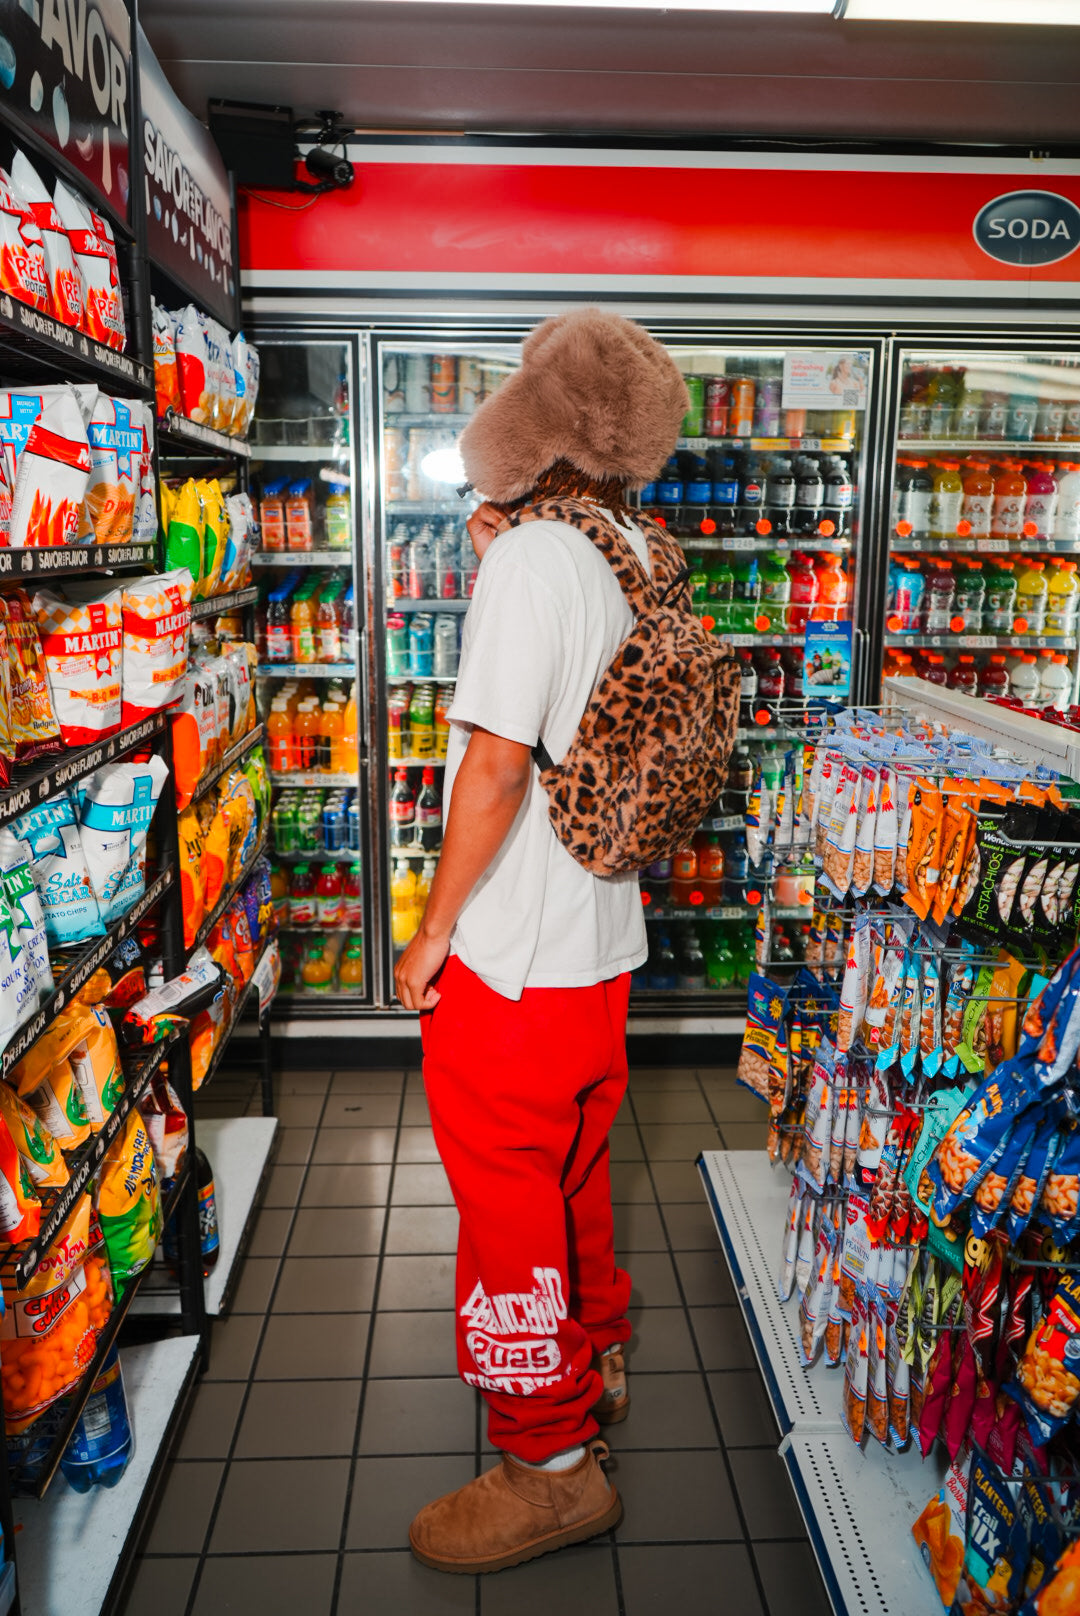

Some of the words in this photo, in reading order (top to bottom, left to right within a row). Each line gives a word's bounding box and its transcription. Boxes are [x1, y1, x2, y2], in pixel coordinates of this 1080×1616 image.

[38, 0, 128, 139] AVOR
[144, 119, 190, 214] SAVOR
[194, 183, 233, 266] FLAVOR
[988, 218, 1071, 240] SODA
[16, 257, 45, 283] RED
[20, 307, 45, 333] SAVOR
[47, 321, 74, 348] FLAVOR
[94, 346, 114, 367] SAVOR
[116, 354, 134, 376] FLAVOR
[39, 551, 63, 569] SAVOR
[65, 549, 88, 567] FLAVOR
[108, 548, 125, 563] SAVOR
[126, 547, 144, 561] FLAVOR
[119, 731, 137, 750] SAVOR
[138, 719, 154, 739] FLAVOR
[55, 763, 77, 787] SAVOR
[79, 749, 103, 774] FLAVOR
[47, 872, 82, 893] Salt
[976, 852, 1003, 921] PISTACHIOS
[67, 906, 88, 916] CHIPS
[1, 967, 21, 992] SOUR
[70, 967, 91, 994] SAVOR
[93, 938, 113, 966] FLAVOR
[18, 1012, 46, 1051] FLAVOR
[133, 1129, 147, 1154] FREE
[130, 1151, 146, 1180] MORE
[41, 1204, 67, 1247] SAVOR
[66, 1160, 90, 1201] FLAVOR
[845, 1238, 870, 1262] PEANUTS
[473, 1336, 550, 1369] 2025
[974, 1467, 1014, 1527] PLANTERS
[972, 1496, 999, 1533] Trail
